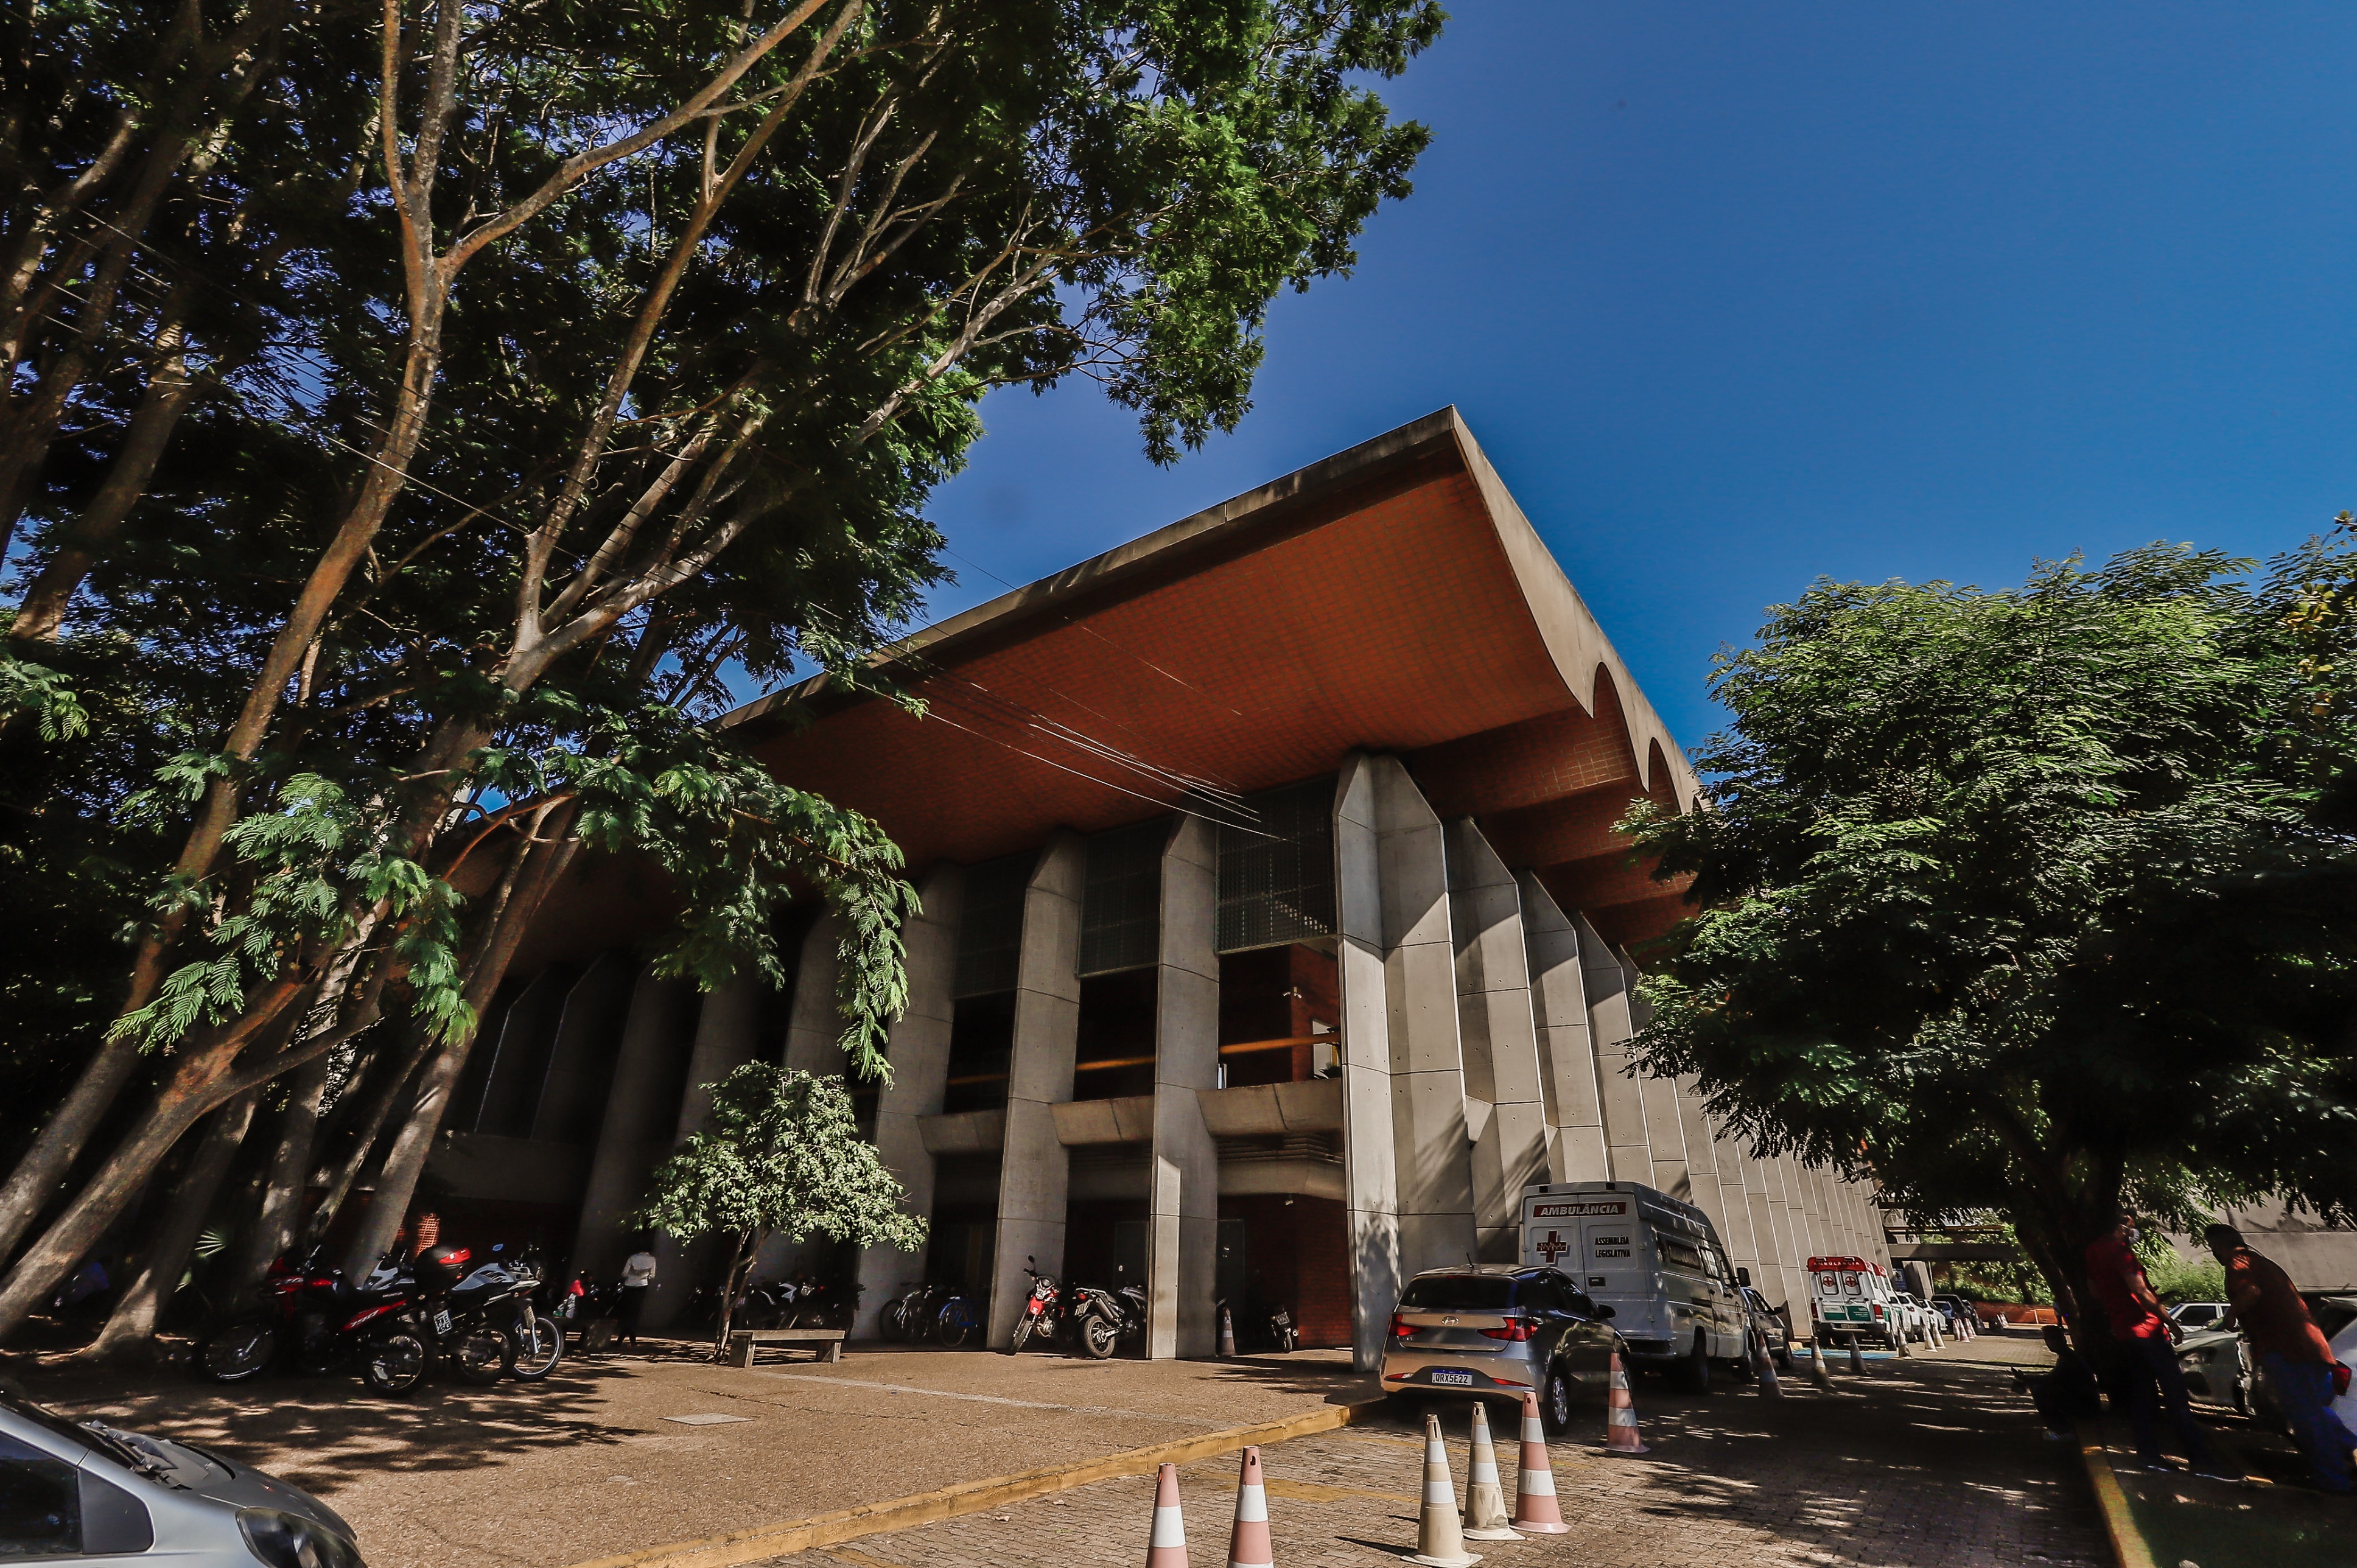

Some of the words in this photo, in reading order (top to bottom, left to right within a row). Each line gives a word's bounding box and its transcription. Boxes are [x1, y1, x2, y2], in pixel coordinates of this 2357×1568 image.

[1540, 1204, 1619, 1216] AMBULÂNCIA
[1595, 1249, 1631, 1258] LEGISLATIVA
[1435, 1373, 1468, 1384] QRX5E22
